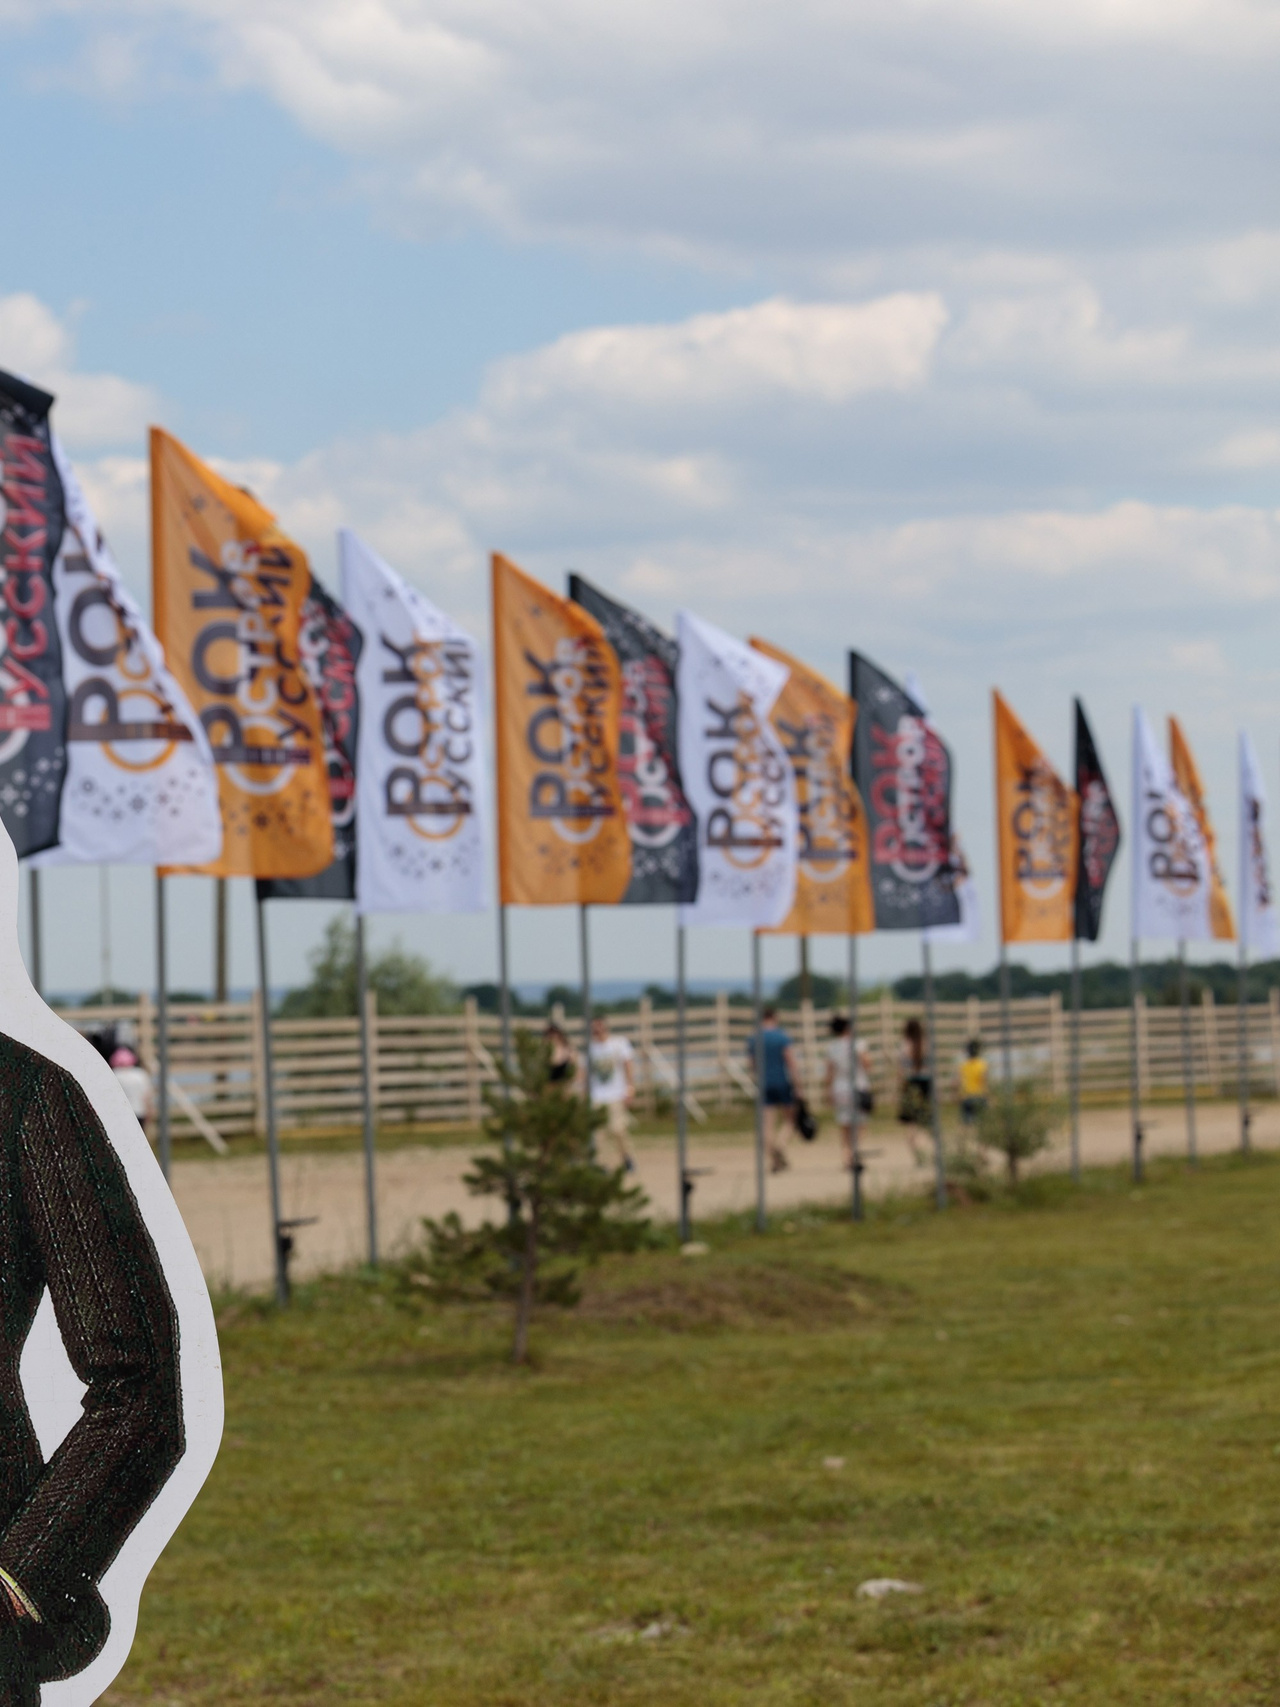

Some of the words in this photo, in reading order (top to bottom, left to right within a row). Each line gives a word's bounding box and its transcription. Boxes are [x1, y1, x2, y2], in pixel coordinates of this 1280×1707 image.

[190, 547, 310, 764] РОК
[379, 633, 472, 815] РОК
[524, 650, 614, 818] РОК
[705, 698, 782, 847] РОК
[870, 724, 947, 865] РОК
